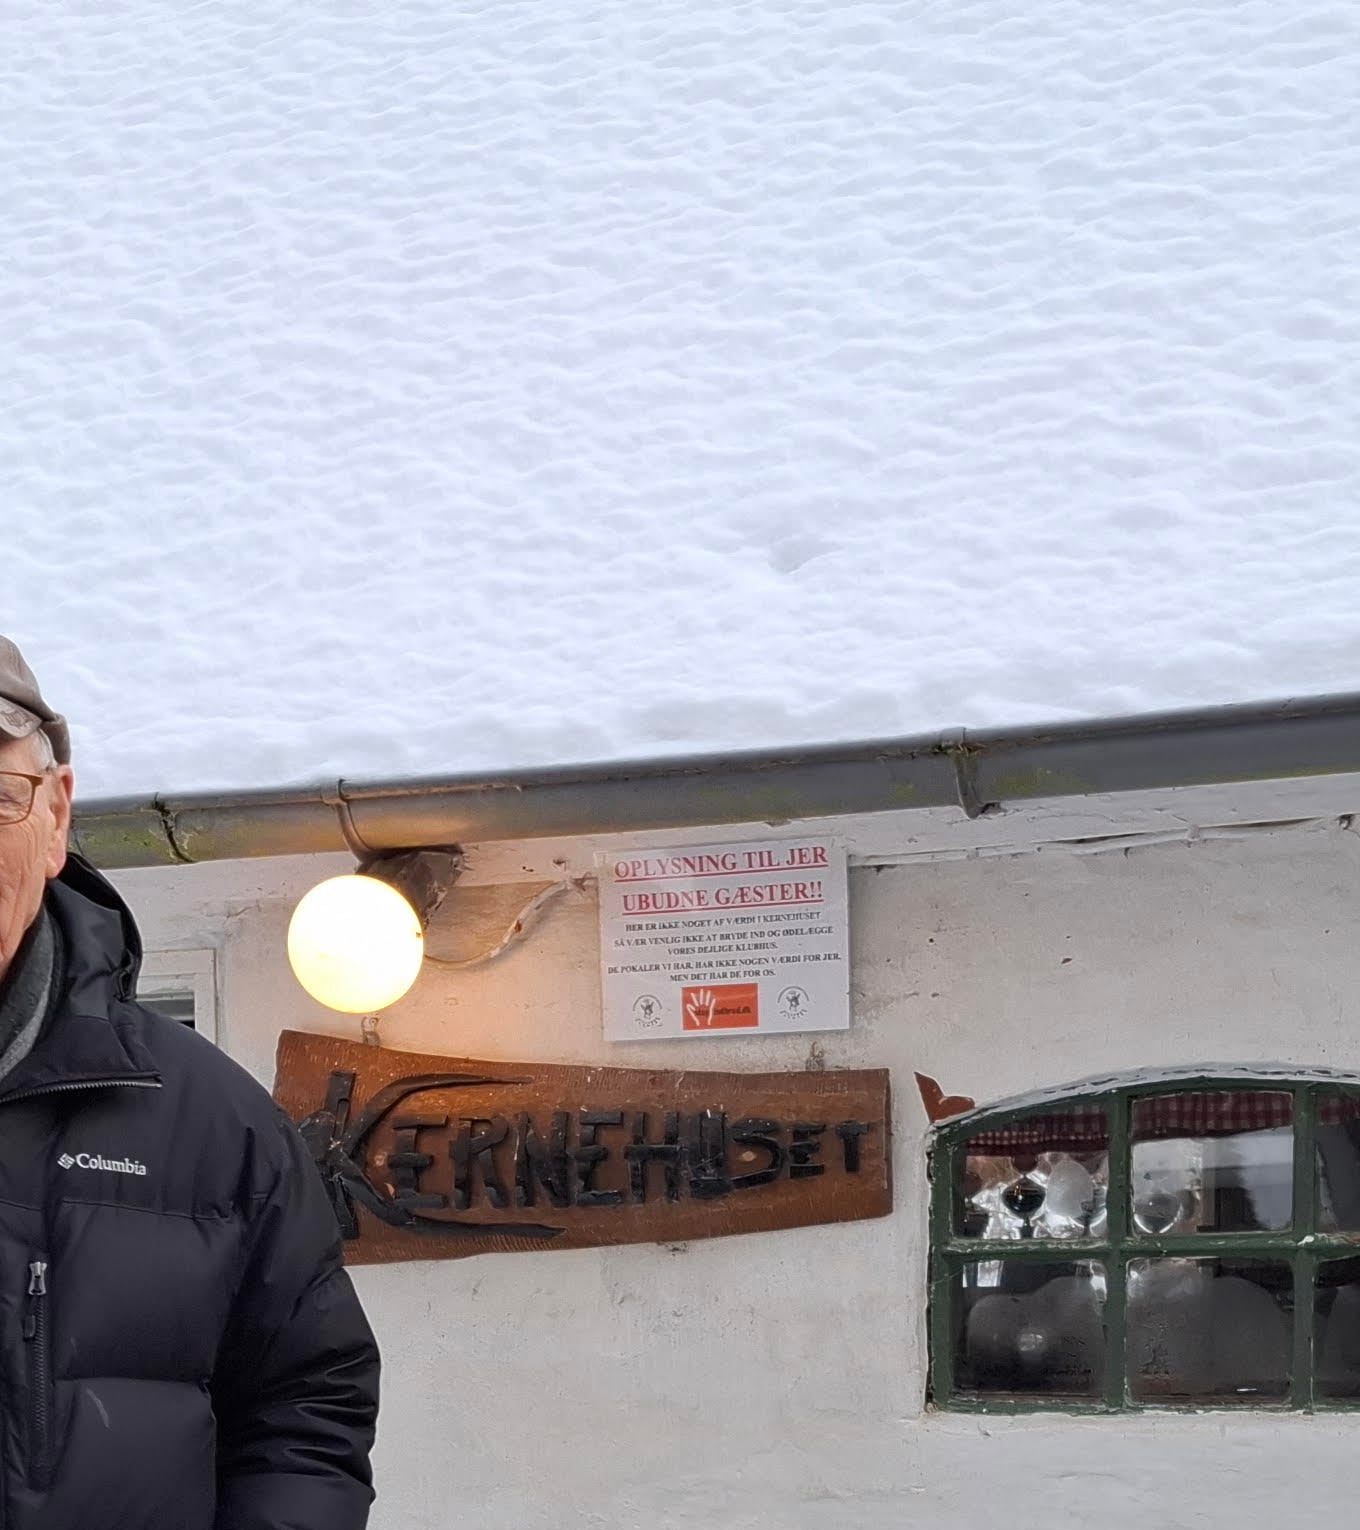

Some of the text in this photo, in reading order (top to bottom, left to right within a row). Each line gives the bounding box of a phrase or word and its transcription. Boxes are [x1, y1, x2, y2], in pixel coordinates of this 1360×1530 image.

[614, 846, 828, 878] OPLYSNING TIL JER
[622, 881, 822, 911] UBUDNE GÆSTER!!
[645, 922, 657, 931] ER
[659, 921, 680, 930] IKKE
[681, 919, 712, 929] NOGET
[714, 918, 725, 927] AF
[726, 915, 755, 925] VÆRDI
[762, 911, 821, 923] KERNEHUSET
[614, 925, 834, 947] SÅ VÆR VENLIG IKKE AT BRYDE IND OG ØDELÆGGE
[667, 946, 696, 955] VORES
[697, 944, 735, 954] DEJLIGE
[620, 963, 660, 974] POKALER
[661, 963, 672, 971] VI
[695, 960, 714, 969] HAR
[715, 958, 738, 968] IKKE
[738, 956, 771, 967] NOGEN
[771, 954, 801, 964] VÆRDI
[802, 953, 821, 962] FOR
[670, 973, 689, 982] MEN
[690, 972, 708, 981] DET
[709, 971, 728, 980] HAR
[729, 970, 741, 978] DE
[743, 969, 761, 978] FOR
[76, 1153, 147, 1176] Columbia
[298, 1071, 871, 1240] KERNEHUSET
